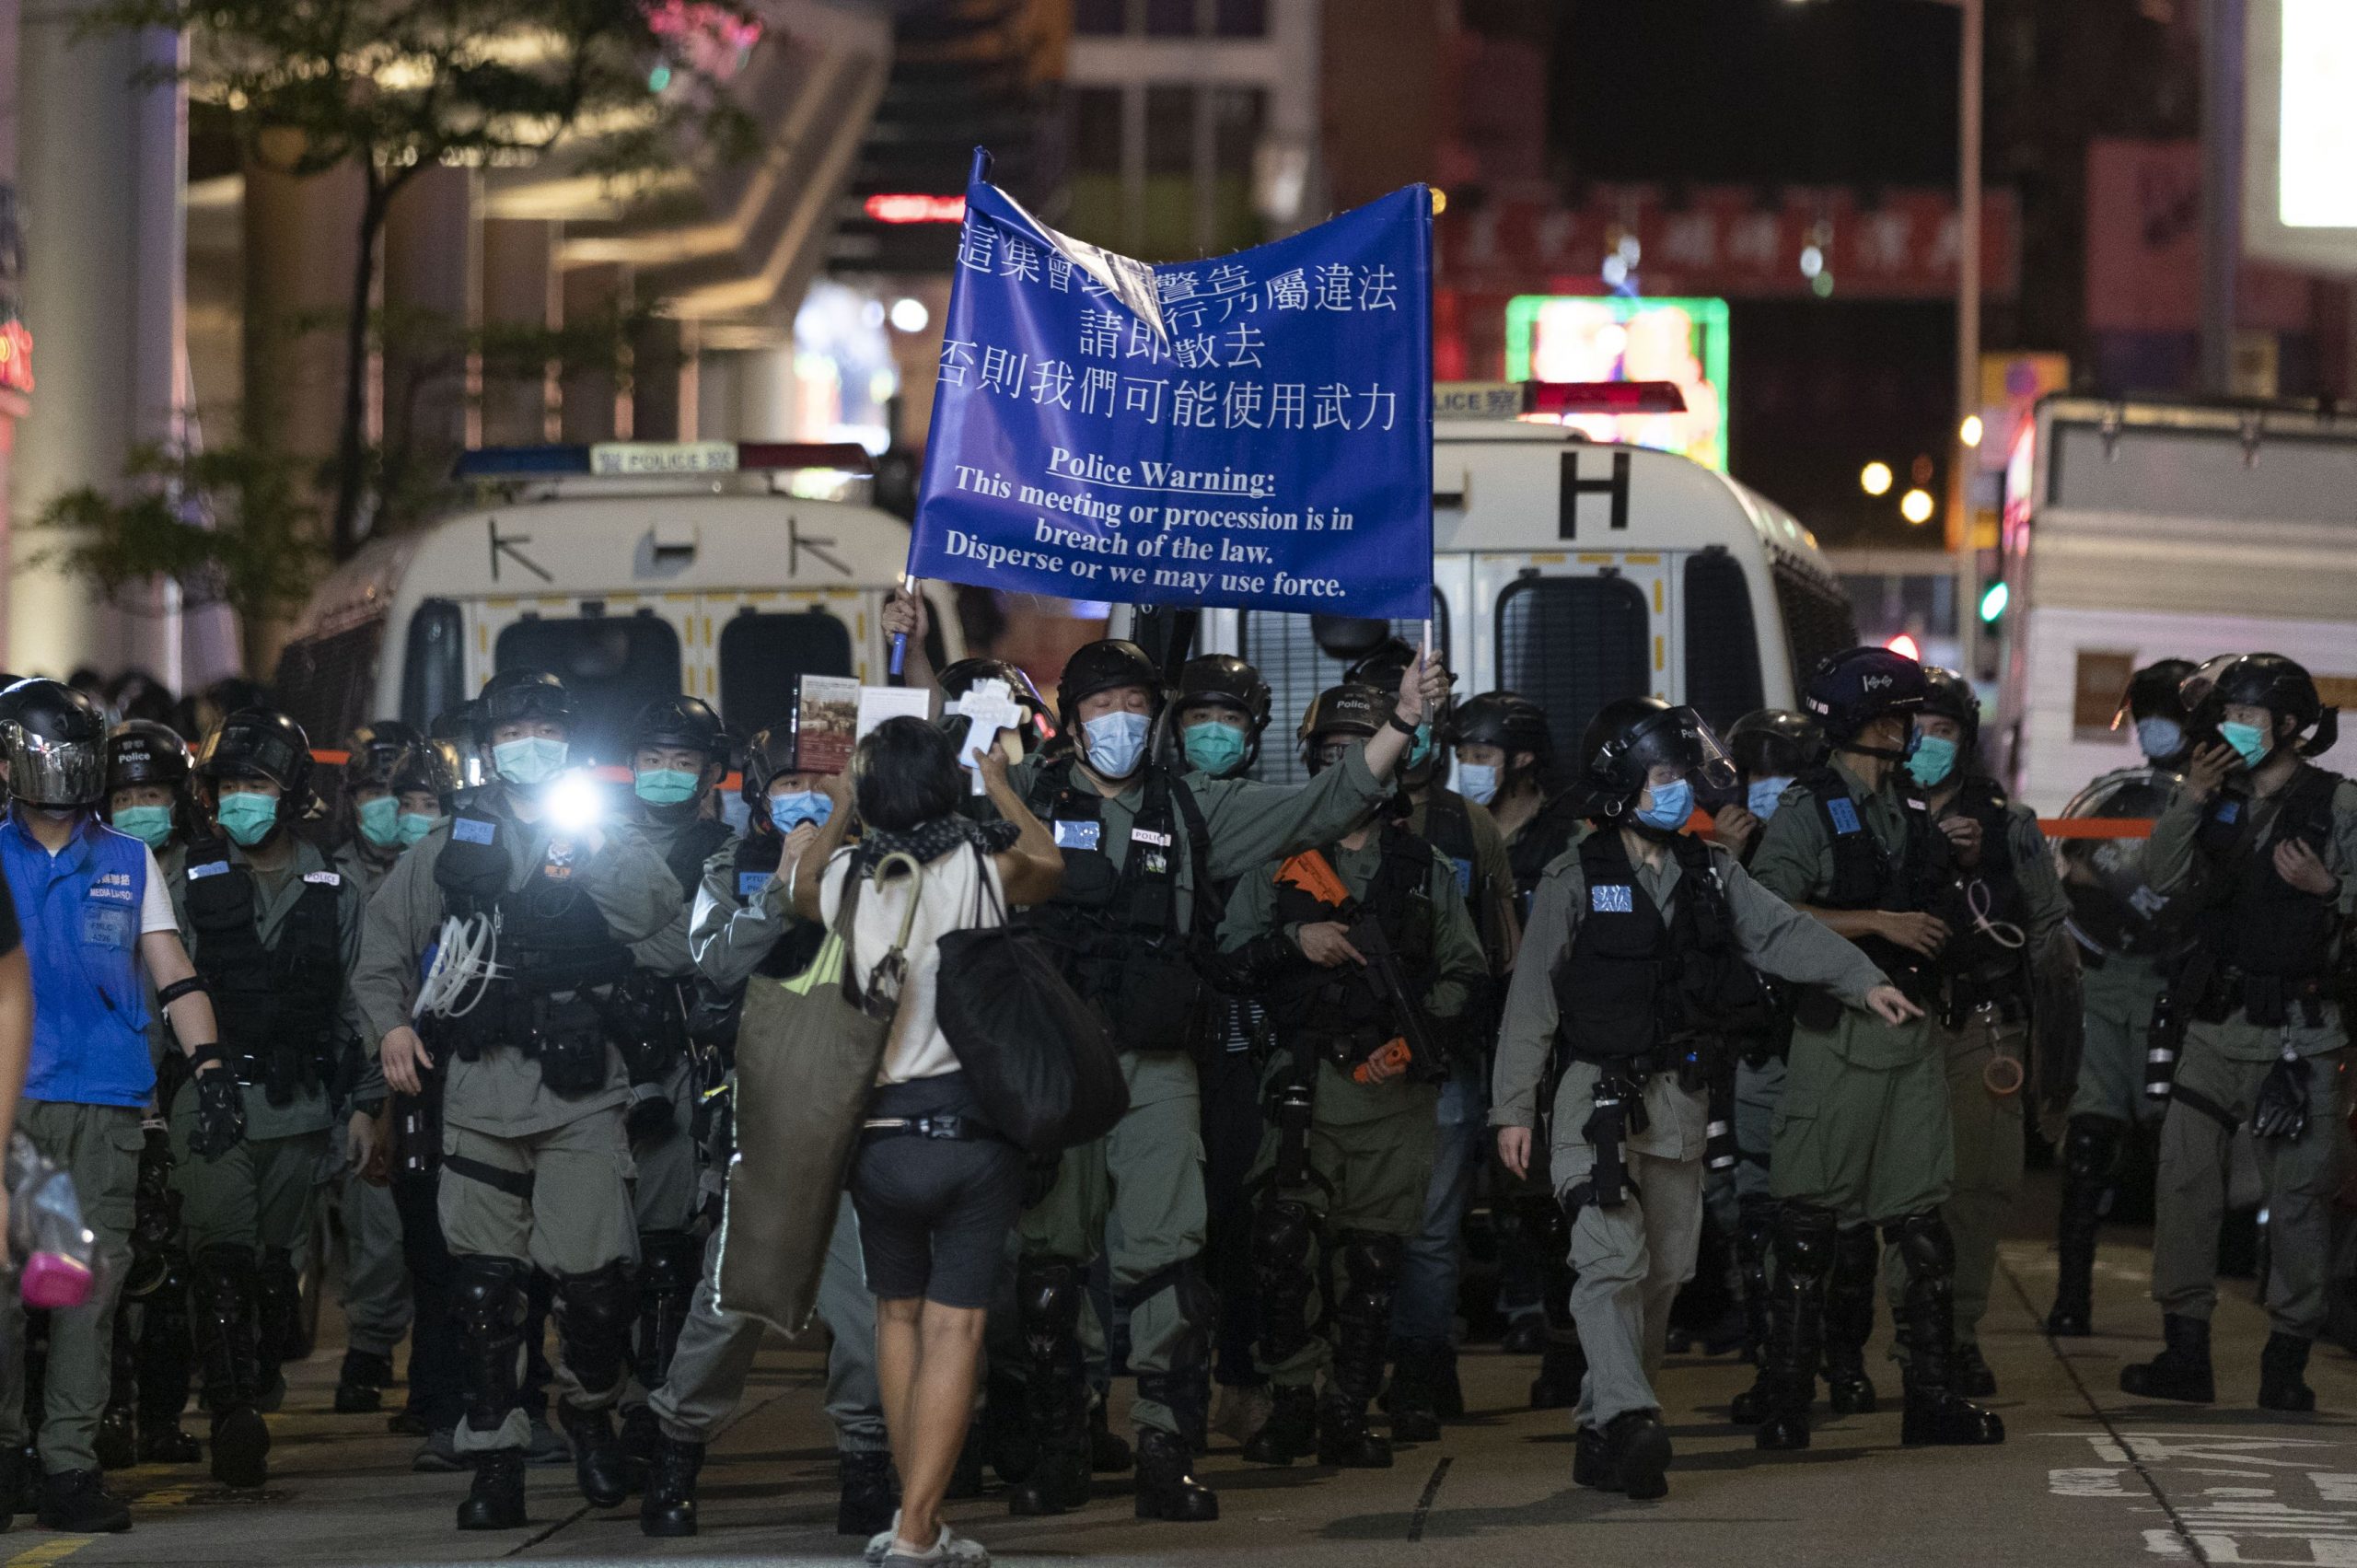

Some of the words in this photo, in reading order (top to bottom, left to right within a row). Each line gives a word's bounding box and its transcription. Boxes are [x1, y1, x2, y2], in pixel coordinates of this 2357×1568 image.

[1080, 309, 1266, 369] 請即散去
[937, 339, 1397, 431] 否則我們可能使用武力
[955, 464, 1012, 499] This
[1018, 484, 1122, 528] meeting
[1129, 505, 1159, 524] or
[1163, 505, 1298, 531] procession
[1305, 506, 1324, 531] is
[1329, 506, 1353, 531] in
[1047, 446, 1132, 485] Police
[1140, 460, 1276, 499] Warning:
[1558, 450, 1632, 540] H
[944, 528, 1063, 573] Disperse
[1070, 560, 1103, 580] or
[1109, 565, 1147, 584] we
[1153, 568, 1214, 595] may
[1221, 574, 1265, 593] use
[1271, 571, 1346, 597] force.
[1035, 517, 1128, 555] breach
[1136, 534, 1168, 557] of
[1171, 536, 1213, 561] the
[1220, 538, 1273, 564] law.
[1337, 699, 1371, 710] Police
[118, 751, 151, 765] Police
[90, 888, 111, 898] MEDIA
[307, 872, 336, 884] POLICE
